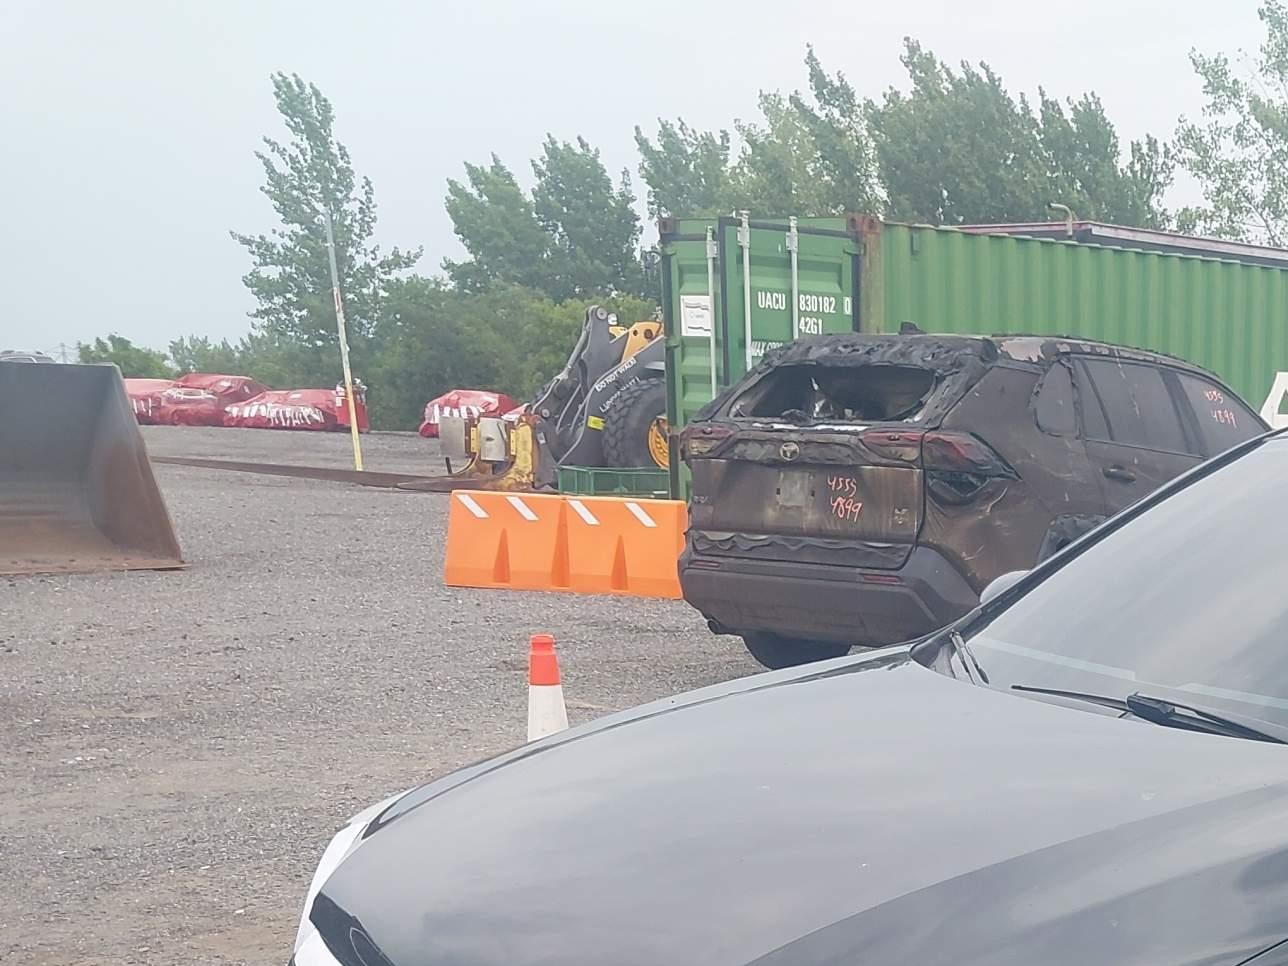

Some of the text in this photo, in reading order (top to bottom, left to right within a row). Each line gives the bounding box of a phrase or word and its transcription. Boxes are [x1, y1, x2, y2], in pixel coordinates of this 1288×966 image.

[757, 291, 786, 310] UACU
[799, 294, 836, 314] 830182
[799, 316, 822, 335] 42G1
[830, 495, 863, 523] 4899
